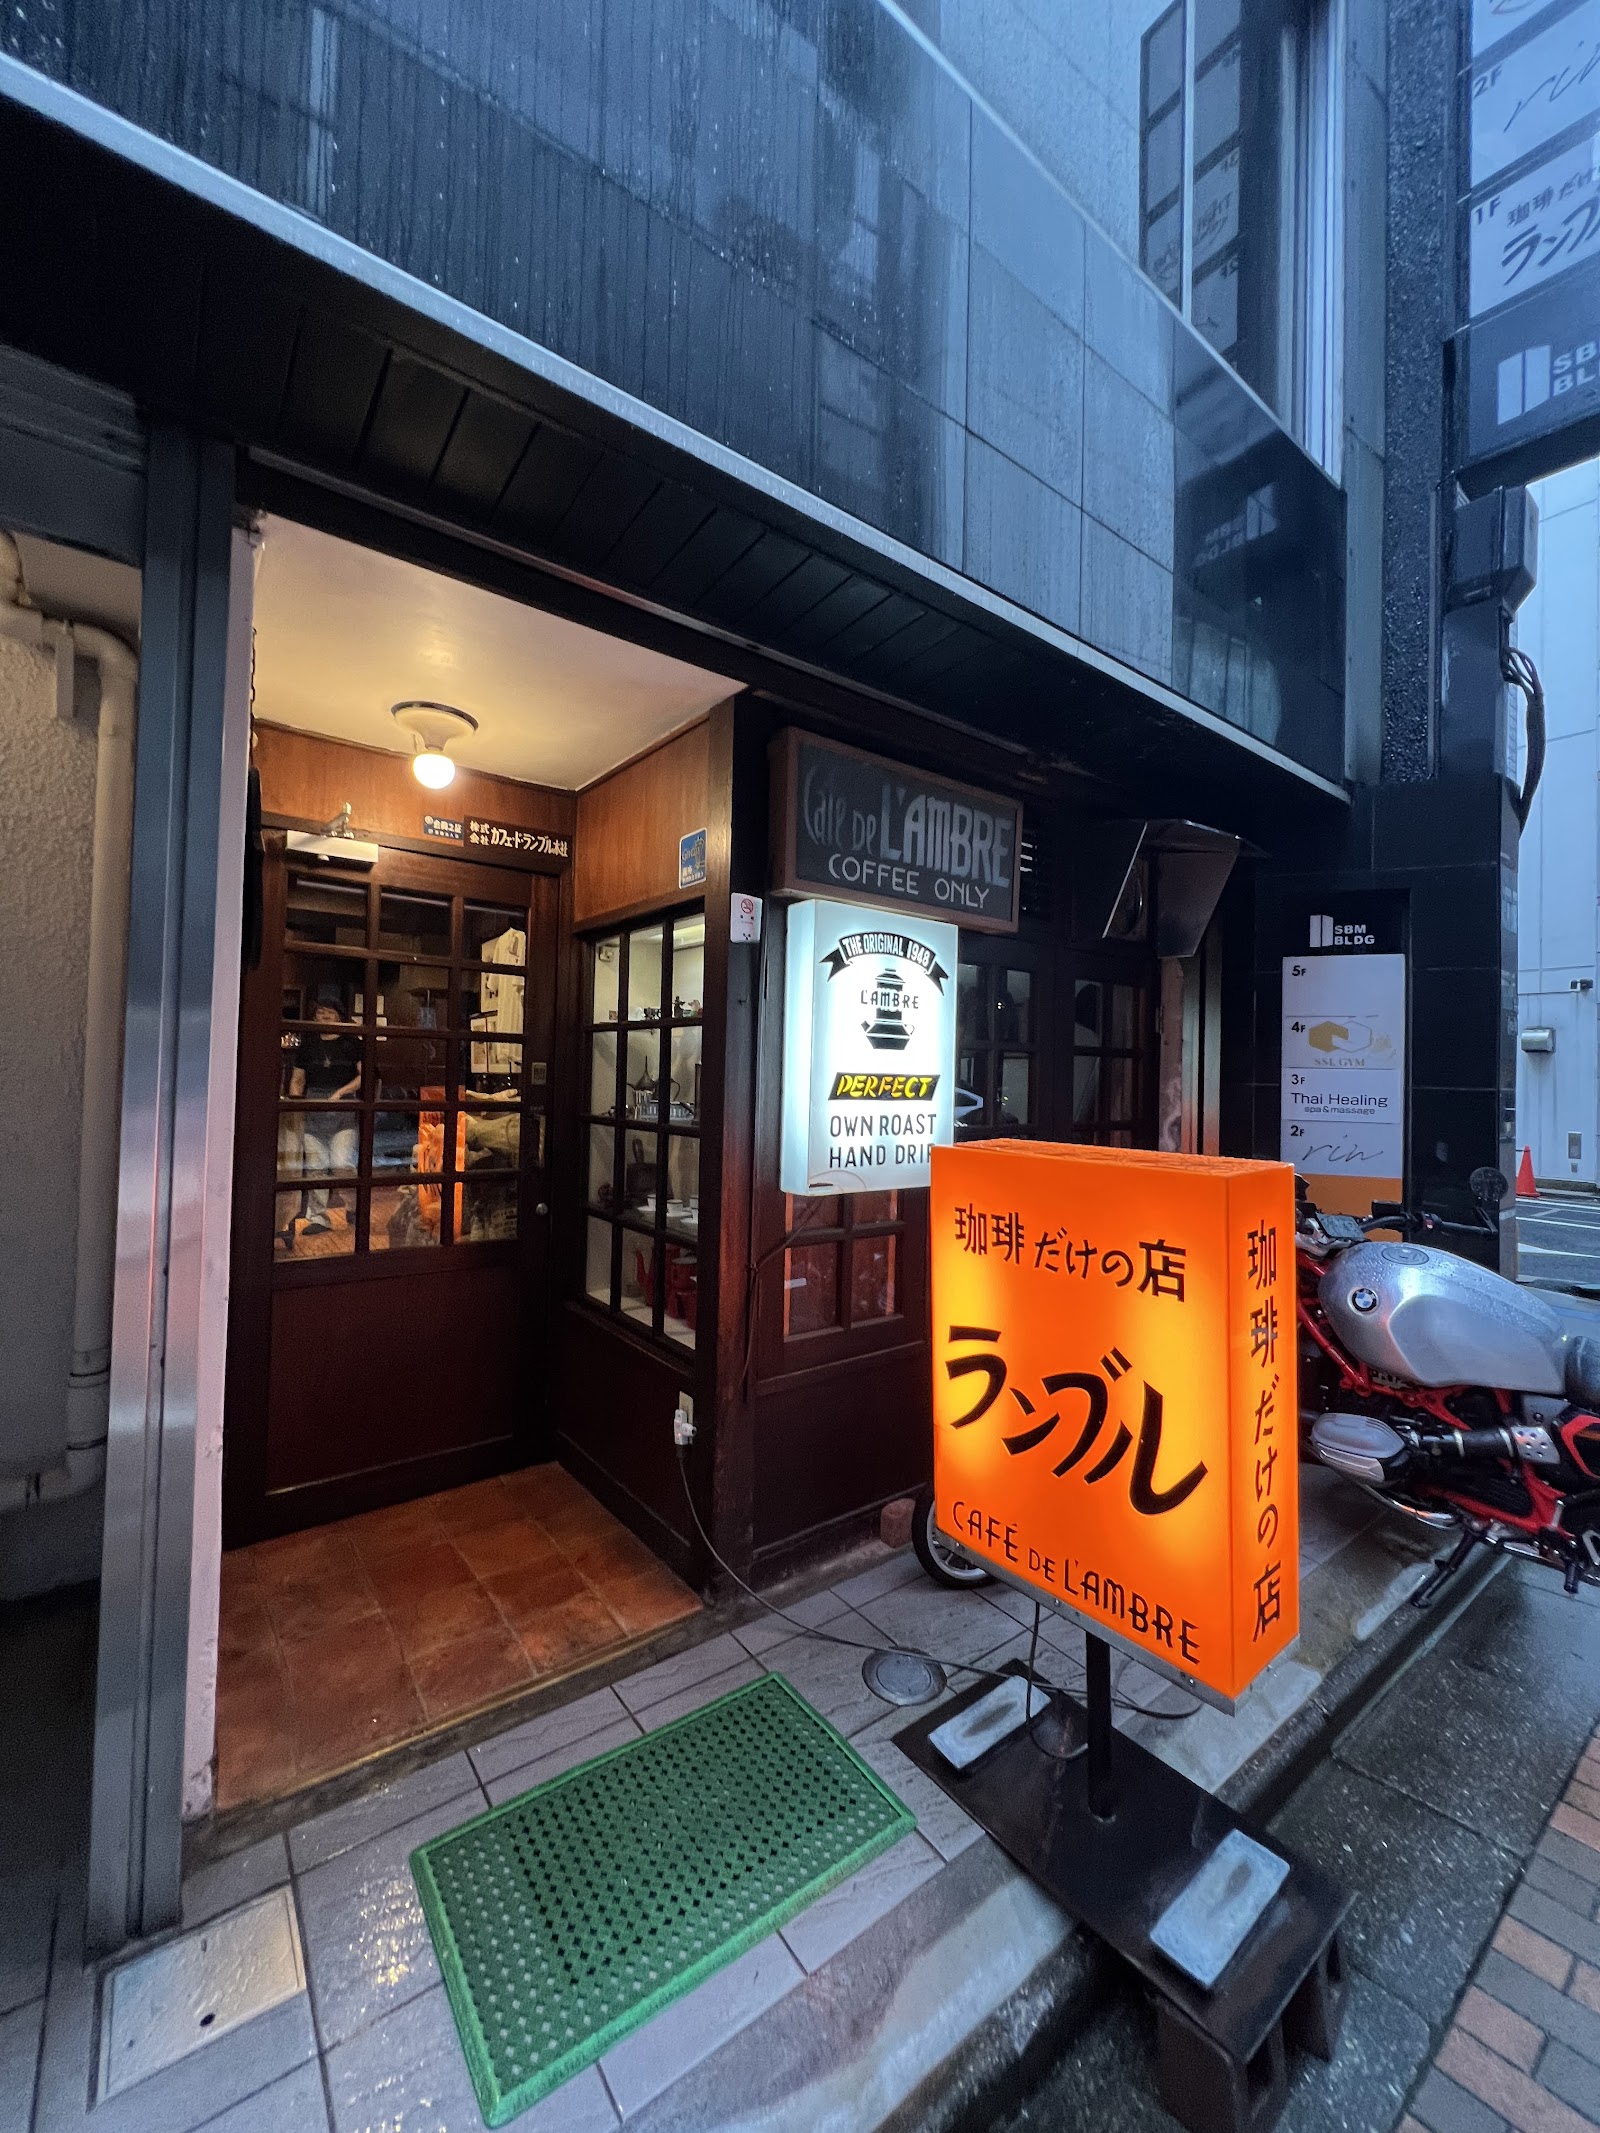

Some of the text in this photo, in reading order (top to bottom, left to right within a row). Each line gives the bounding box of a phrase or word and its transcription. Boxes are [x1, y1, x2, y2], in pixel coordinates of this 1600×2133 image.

[1474, 65, 1502, 98] 2F
[1475, 196, 1501, 225] 1F
[880, 783, 1013, 889] L'AMBRE
[828, 853, 989, 909] COFFEE ONLY
[1334, 924, 1367, 935] SBM
[1334, 935, 1376, 946] BLDG
[841, 933, 931, 967] THE ORIGINAL 1948
[1291, 965, 1307, 977] 5F
[861, 989, 919, 1009] L'AMBRE
[1291, 1021, 1306, 1033] 4F
[1314, 1057, 1365, 1067] SSL GYM
[837, 1074, 933, 1098] PERFECT
[1291, 1074, 1306, 1085] 3F
[1291, 1092, 1389, 1108] Thai Healing
[830, 1113, 937, 1137] OWN ROAST
[1290, 1125, 1305, 1137] 2F
[829, 1145, 886, 1168] HAND
[945, 1325, 1209, 1517] ランブル
[1248, 1220, 1281, 1642] 珈琲だけの店
[953, 1501, 1200, 1666] CAFÉ DE L'AMBRE
